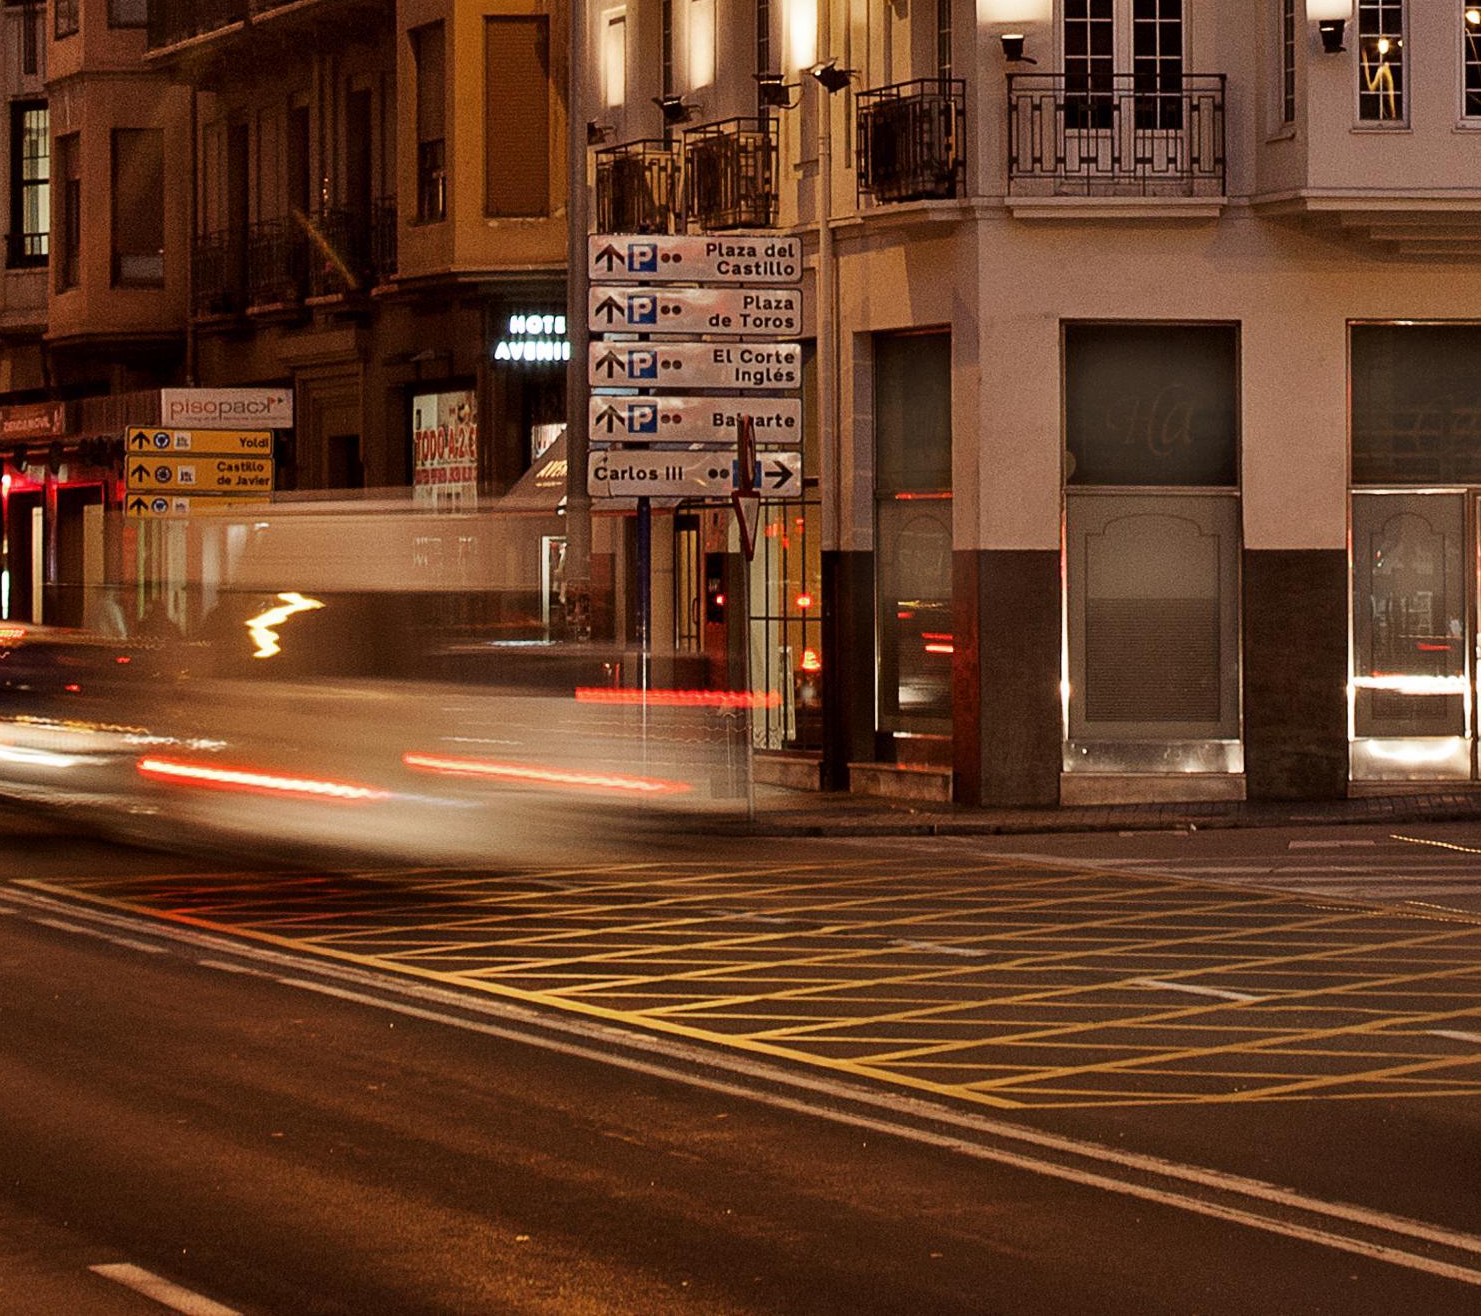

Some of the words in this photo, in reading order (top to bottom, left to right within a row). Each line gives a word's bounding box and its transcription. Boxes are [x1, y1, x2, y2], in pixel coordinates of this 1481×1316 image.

[706, 243, 757, 258] Plaza
[765, 243, 795, 258] del
[717, 260, 795, 276] Castillo
[743, 296, 794, 310] Plaza
[510, 315, 566, 335] HOTE
[709, 314, 732, 328] de
[740, 314, 795, 328] Toros
[713, 350, 732, 364] El
[740, 349, 795, 364] Corte
[735, 368, 795, 385] Inglés
[712, 413, 795, 428] Baarte
[239, 437, 269, 448] Yoldi
[216, 461, 264, 473] Castillo
[593, 466, 658, 481] Carlos
[665, 466, 683, 481] III
[217, 475, 231, 486] de
[236, 475, 270, 486] Javier
